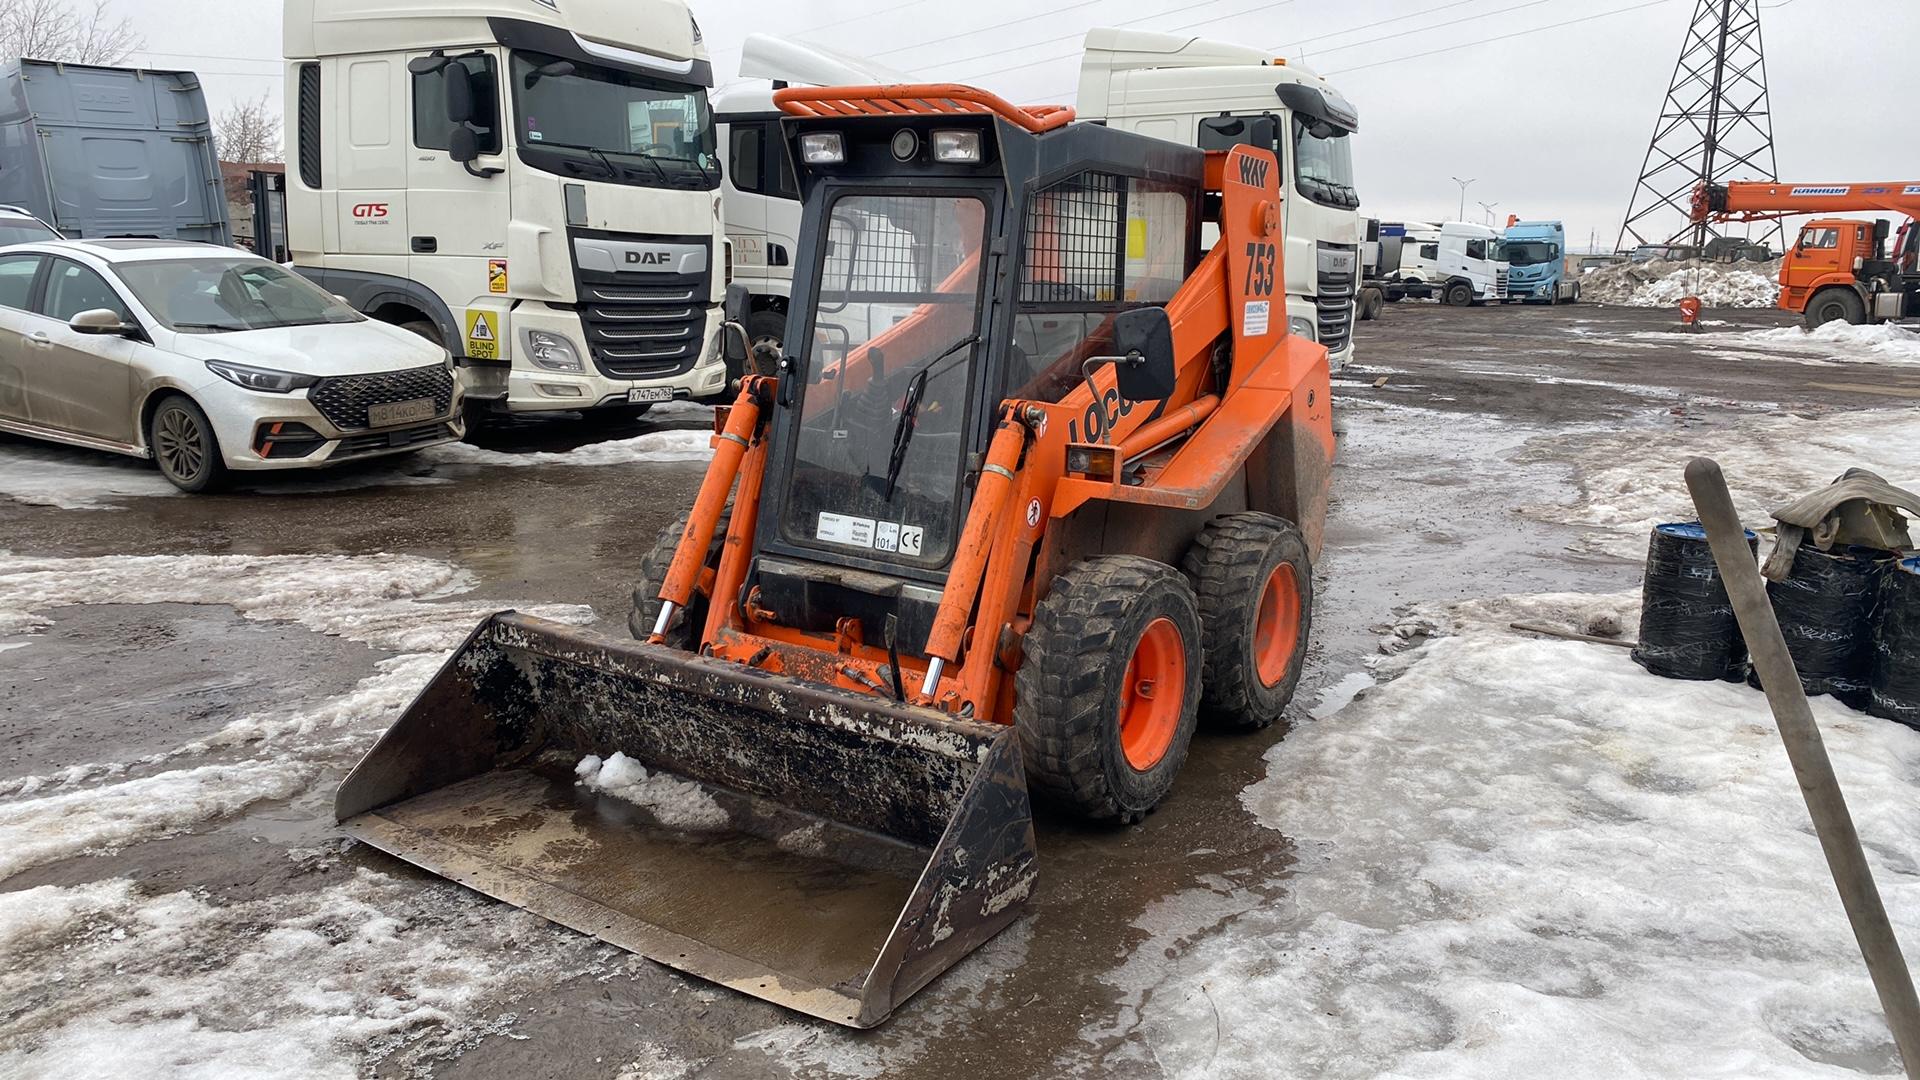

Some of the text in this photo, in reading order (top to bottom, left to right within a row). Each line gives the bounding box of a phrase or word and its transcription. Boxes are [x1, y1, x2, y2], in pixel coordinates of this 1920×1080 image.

[1240, 154, 1269, 189] WAY
[353, 203, 389, 217] GTS
[482, 241, 504, 250] XF
[625, 251, 671, 265] DAF
[1333, 257, 1348, 268] DAF
[1245, 242, 1275, 296] 753
[469, 341, 495, 351] BLIND
[471, 349, 494, 359] SPOT
[876, 537, 890, 549] 101
[902, 532, 921, 549] CE
